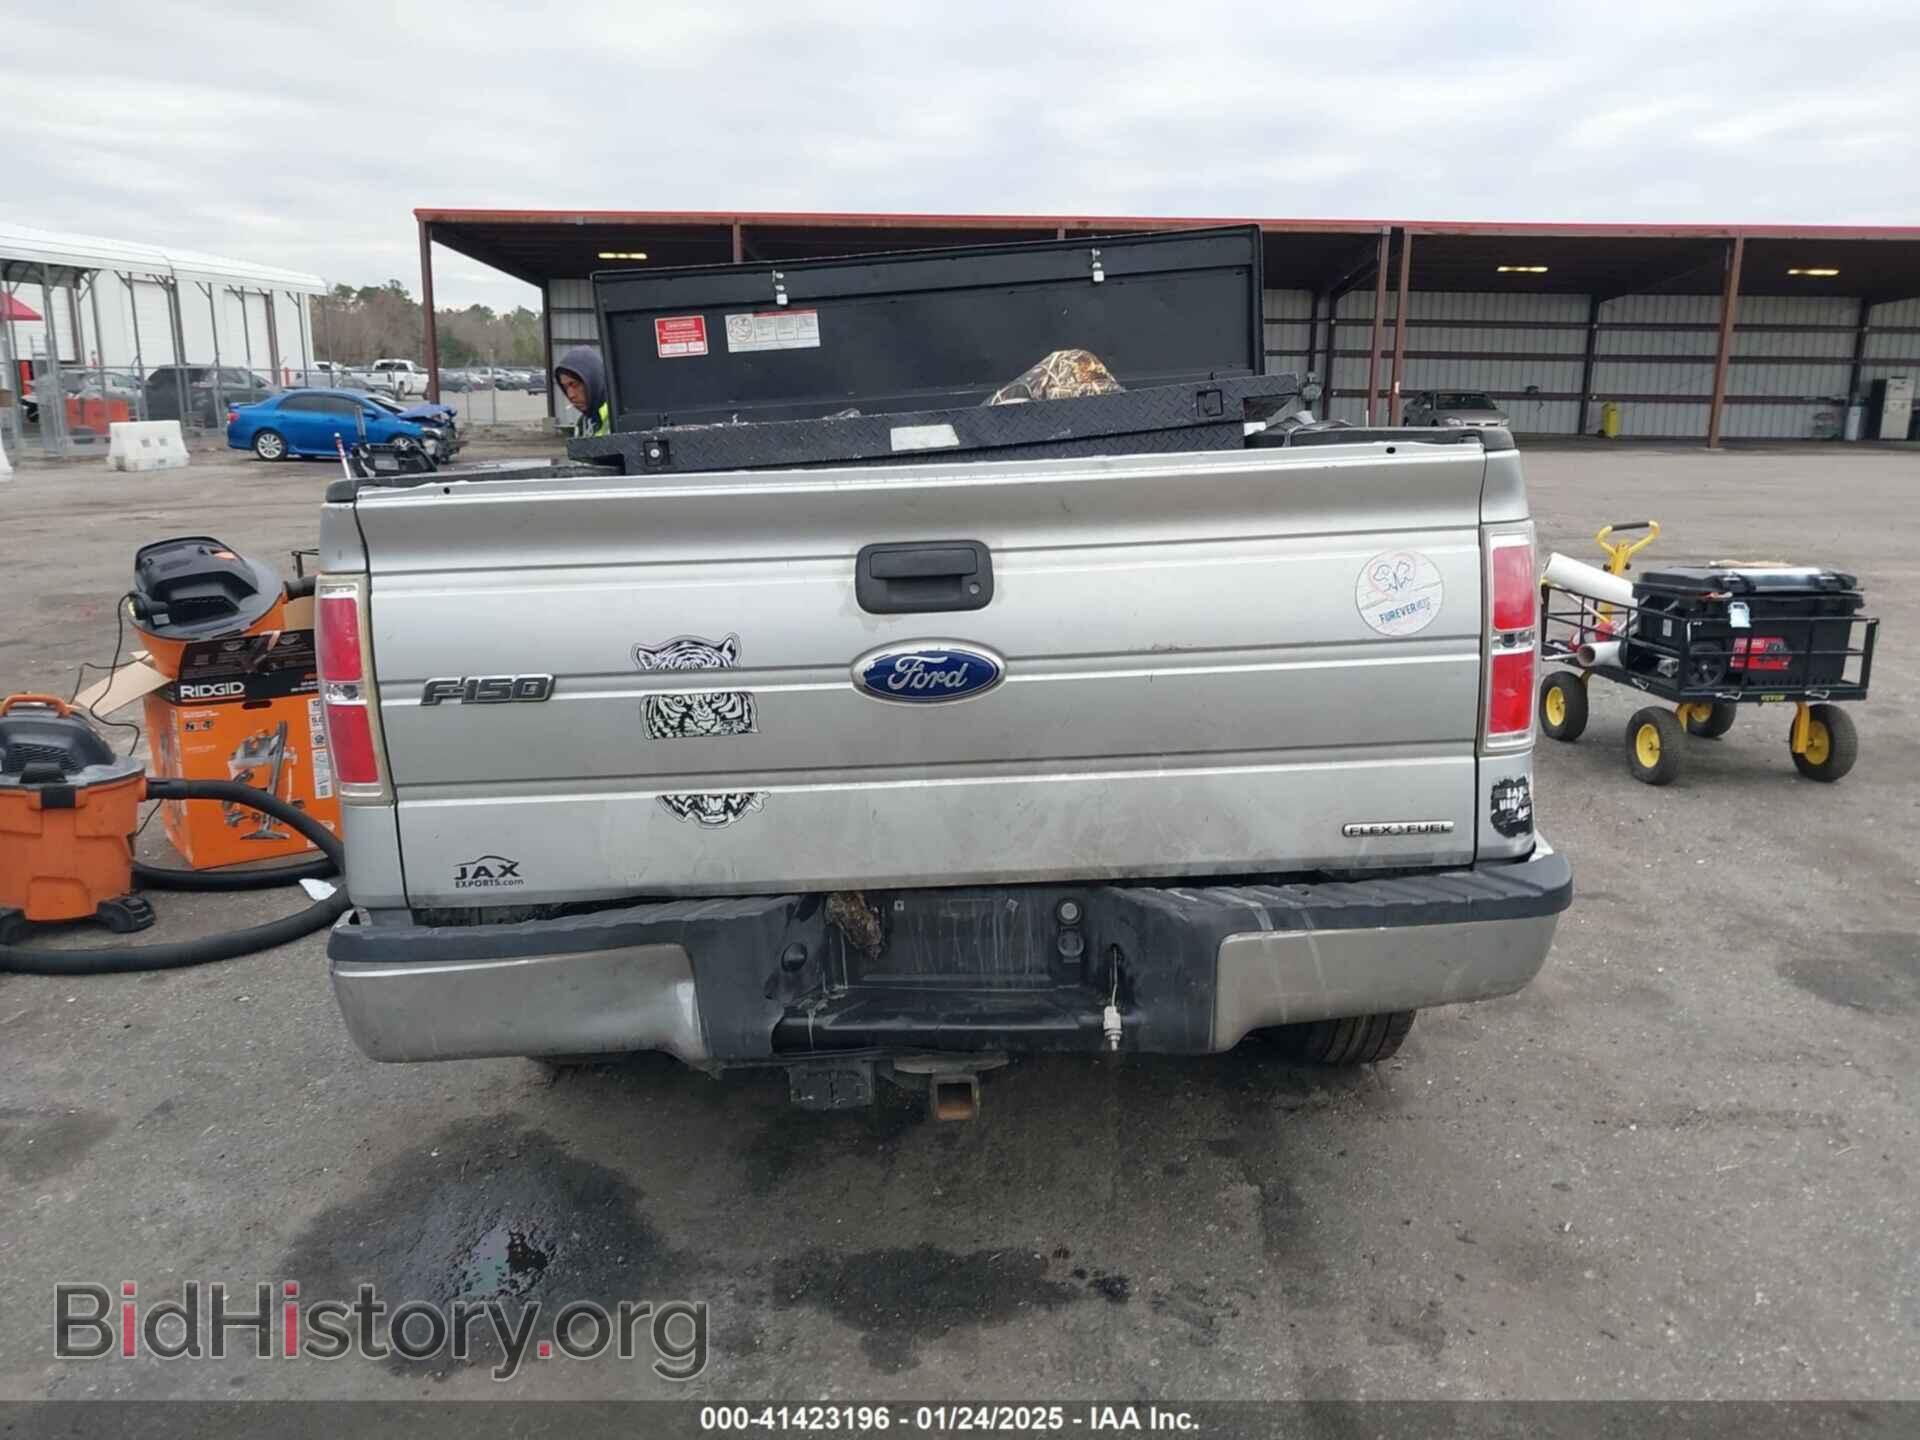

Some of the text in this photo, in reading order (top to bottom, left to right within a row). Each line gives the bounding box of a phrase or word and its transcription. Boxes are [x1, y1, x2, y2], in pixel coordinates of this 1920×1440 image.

[887, 655, 968, 690] Ford
[180, 681, 245, 698] RIDGID
[1349, 823, 1451, 837] FLEX FUEL
[454, 862, 521, 880] JAX
[455, 879, 525, 888] EXPORTS.com
